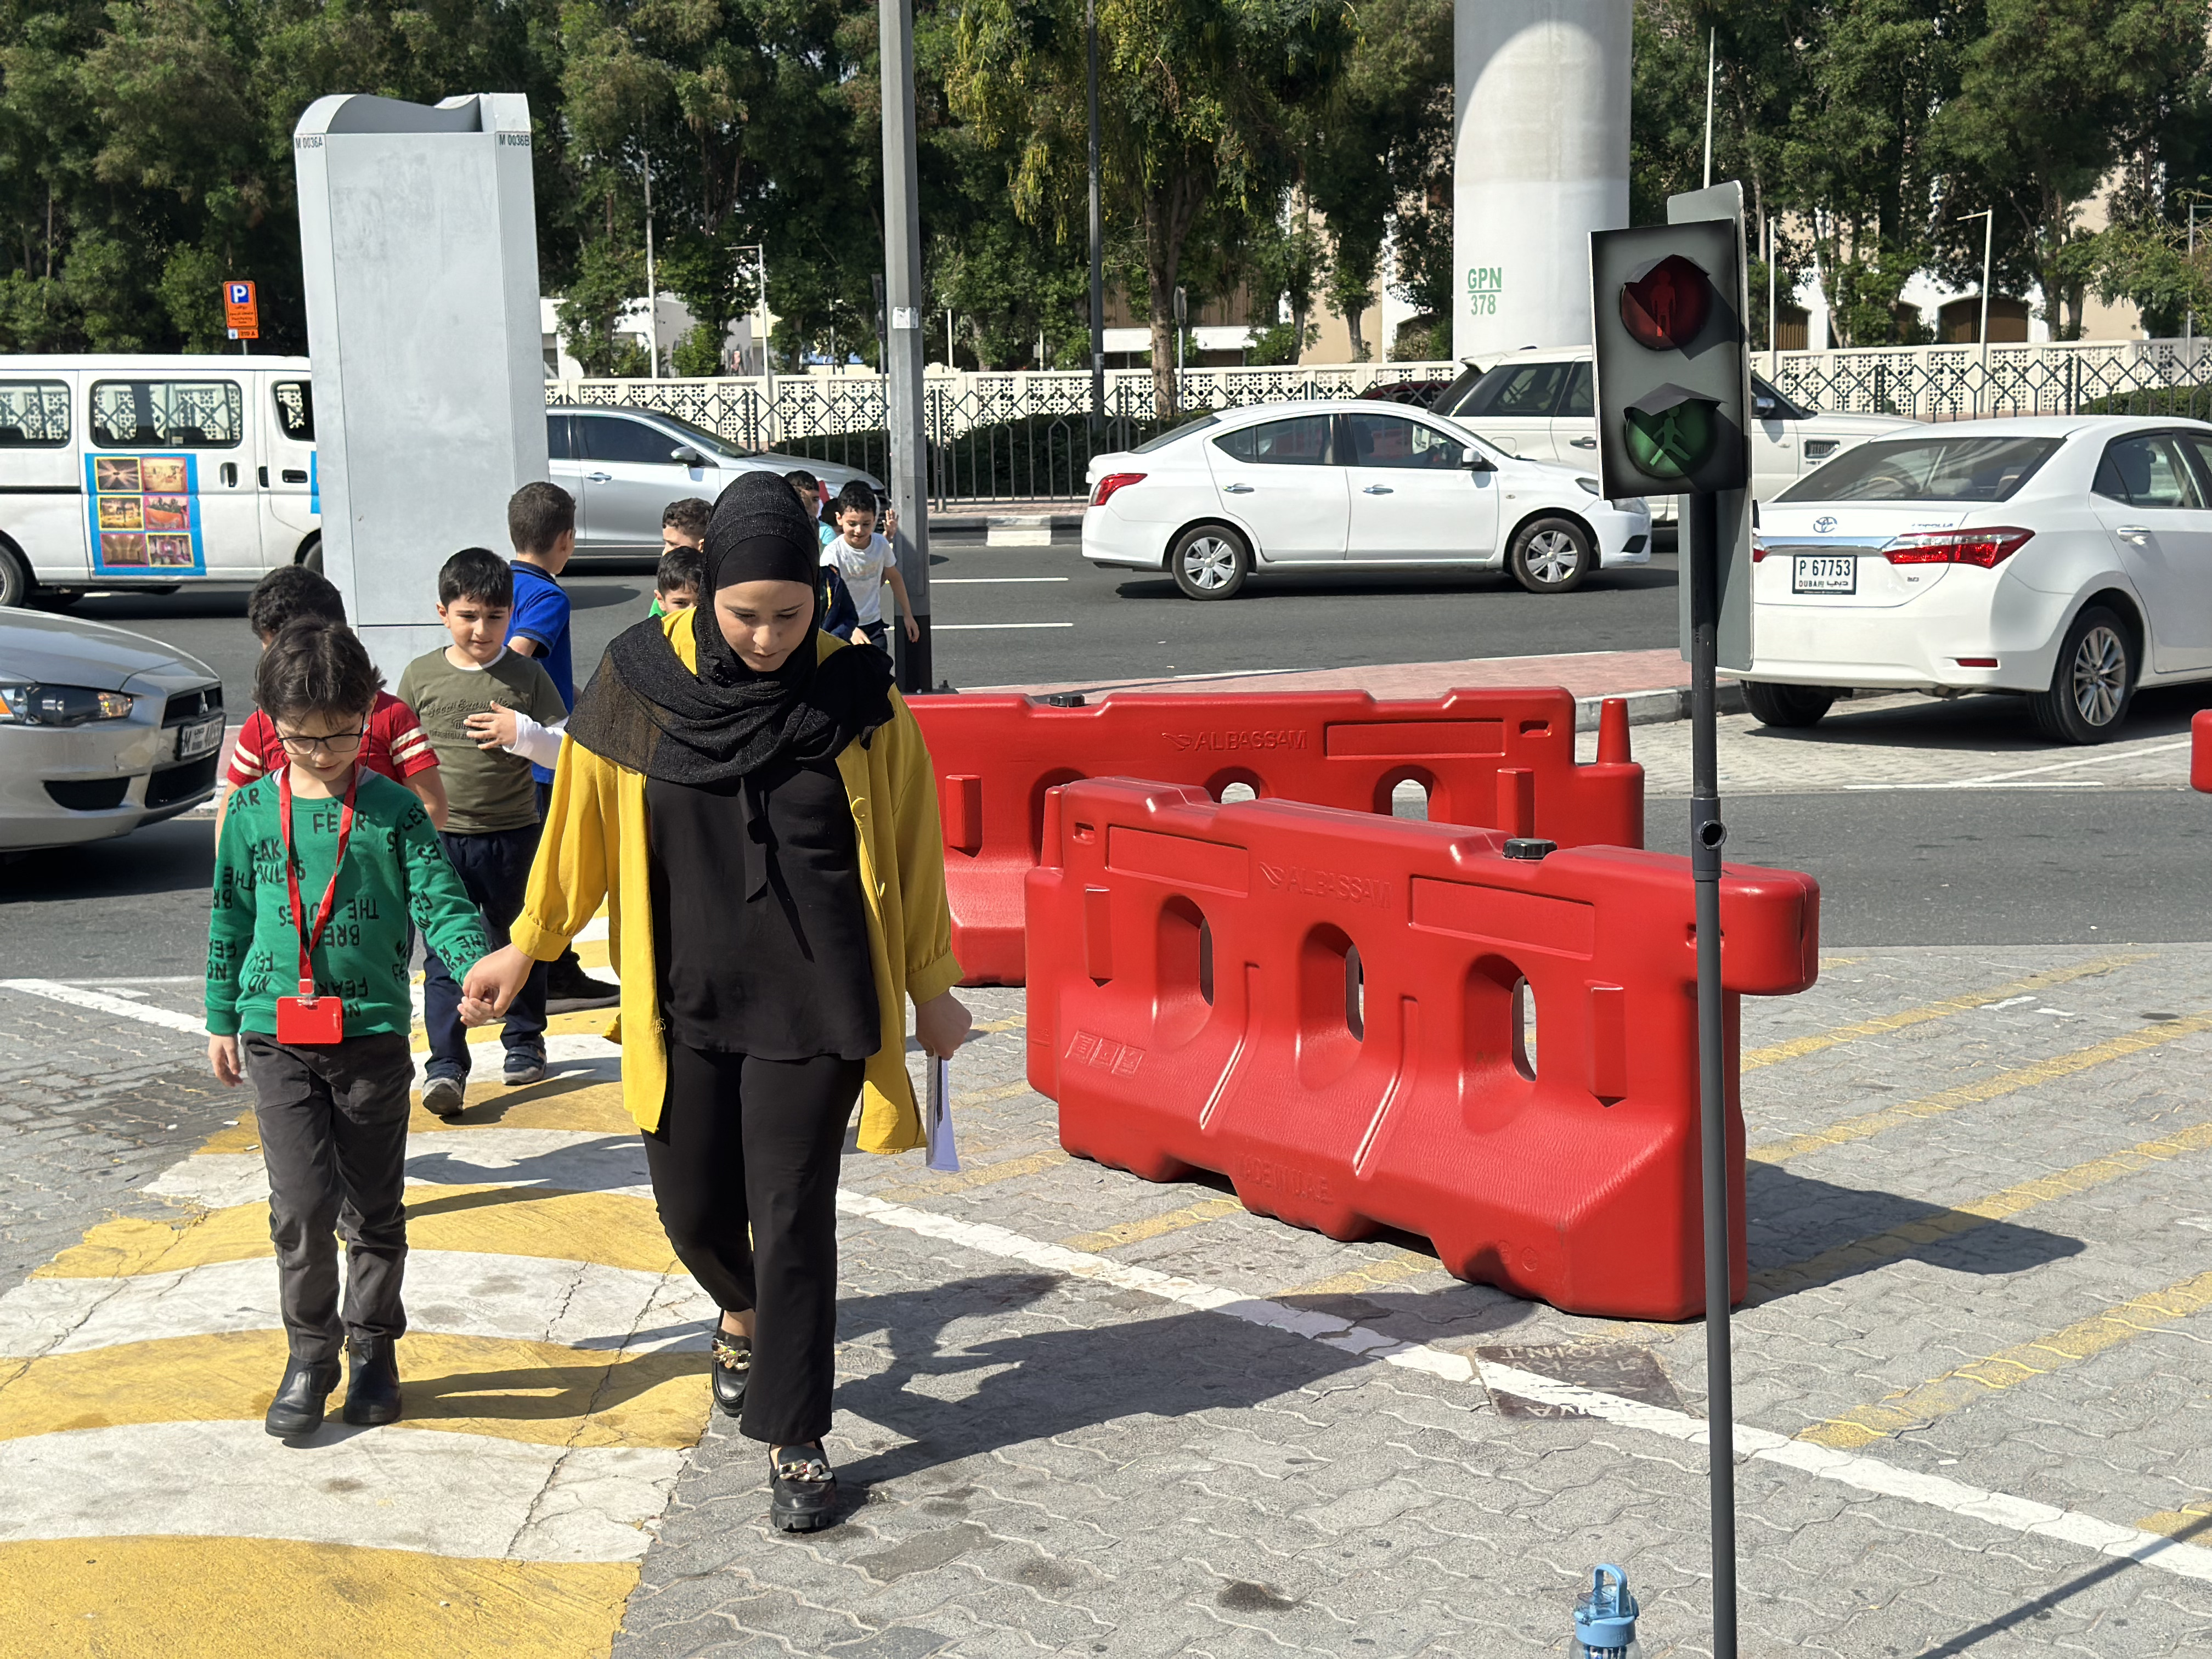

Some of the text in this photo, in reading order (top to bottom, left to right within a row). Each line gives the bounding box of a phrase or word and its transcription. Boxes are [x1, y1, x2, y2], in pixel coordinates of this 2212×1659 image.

[499, 134, 505, 145] M
[1468, 267, 1502, 289] GPN
[233, 285, 247, 303] P
[1471, 294, 1496, 315] 378
[1799, 560, 1850, 576] P 67753
[1194, 730, 1307, 751] ALBASSAM
[313, 810, 366, 834] FER
[256, 859, 306, 884] RULS
[347, 898, 380, 922] THE
[311, 924, 359, 947] BRE
